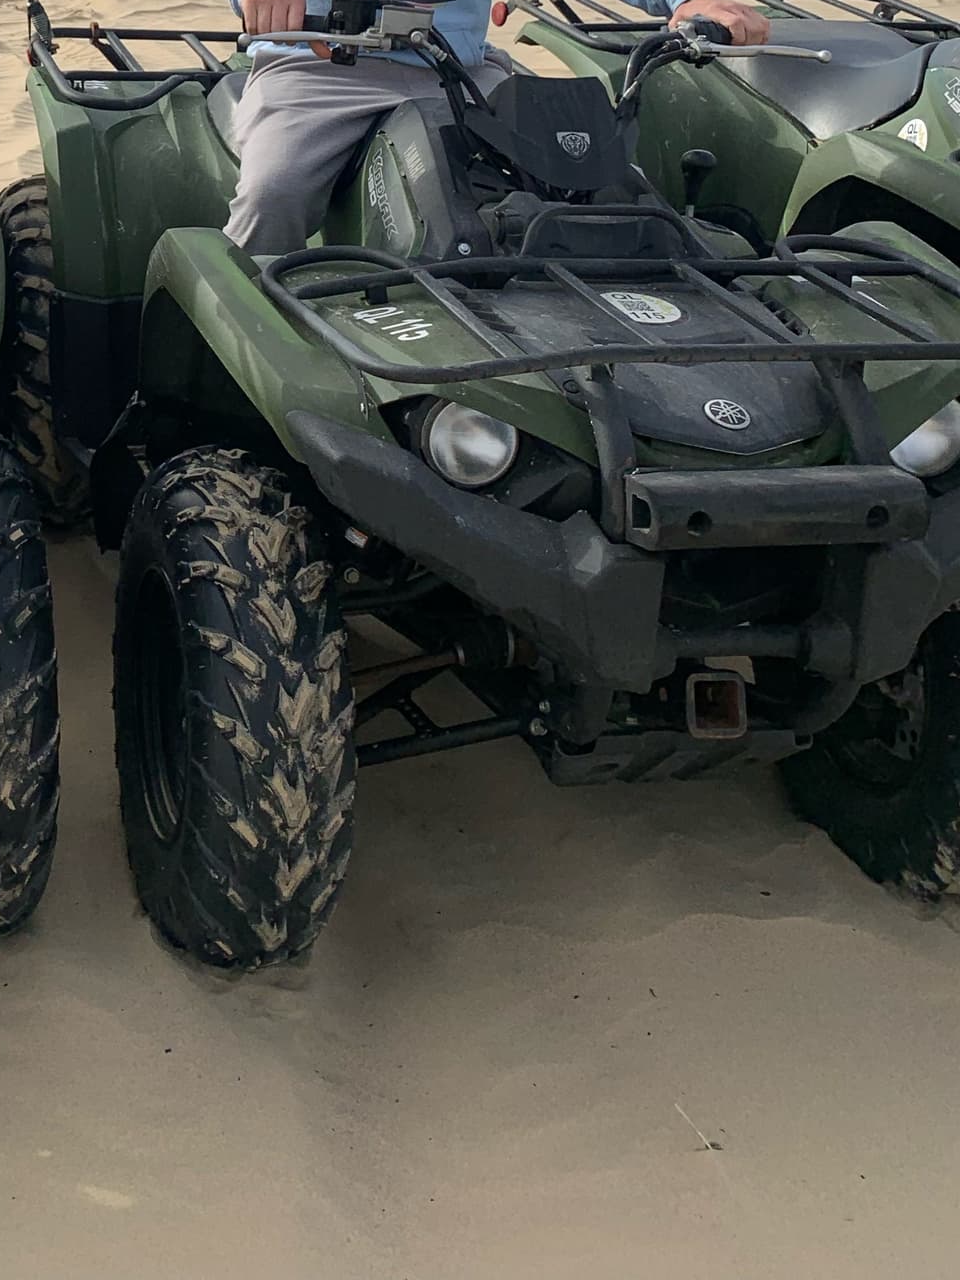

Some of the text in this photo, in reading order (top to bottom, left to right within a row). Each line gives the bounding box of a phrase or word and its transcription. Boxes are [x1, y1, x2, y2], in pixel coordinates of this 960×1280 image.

[907, 123, 918, 134] QL
[403, 142, 426, 183] YAMAHA
[368, 164, 377, 207] 450
[372, 147, 400, 240] KODIAK
[353, 306, 432, 341] QL 115
[630, 311, 665, 320] 115
